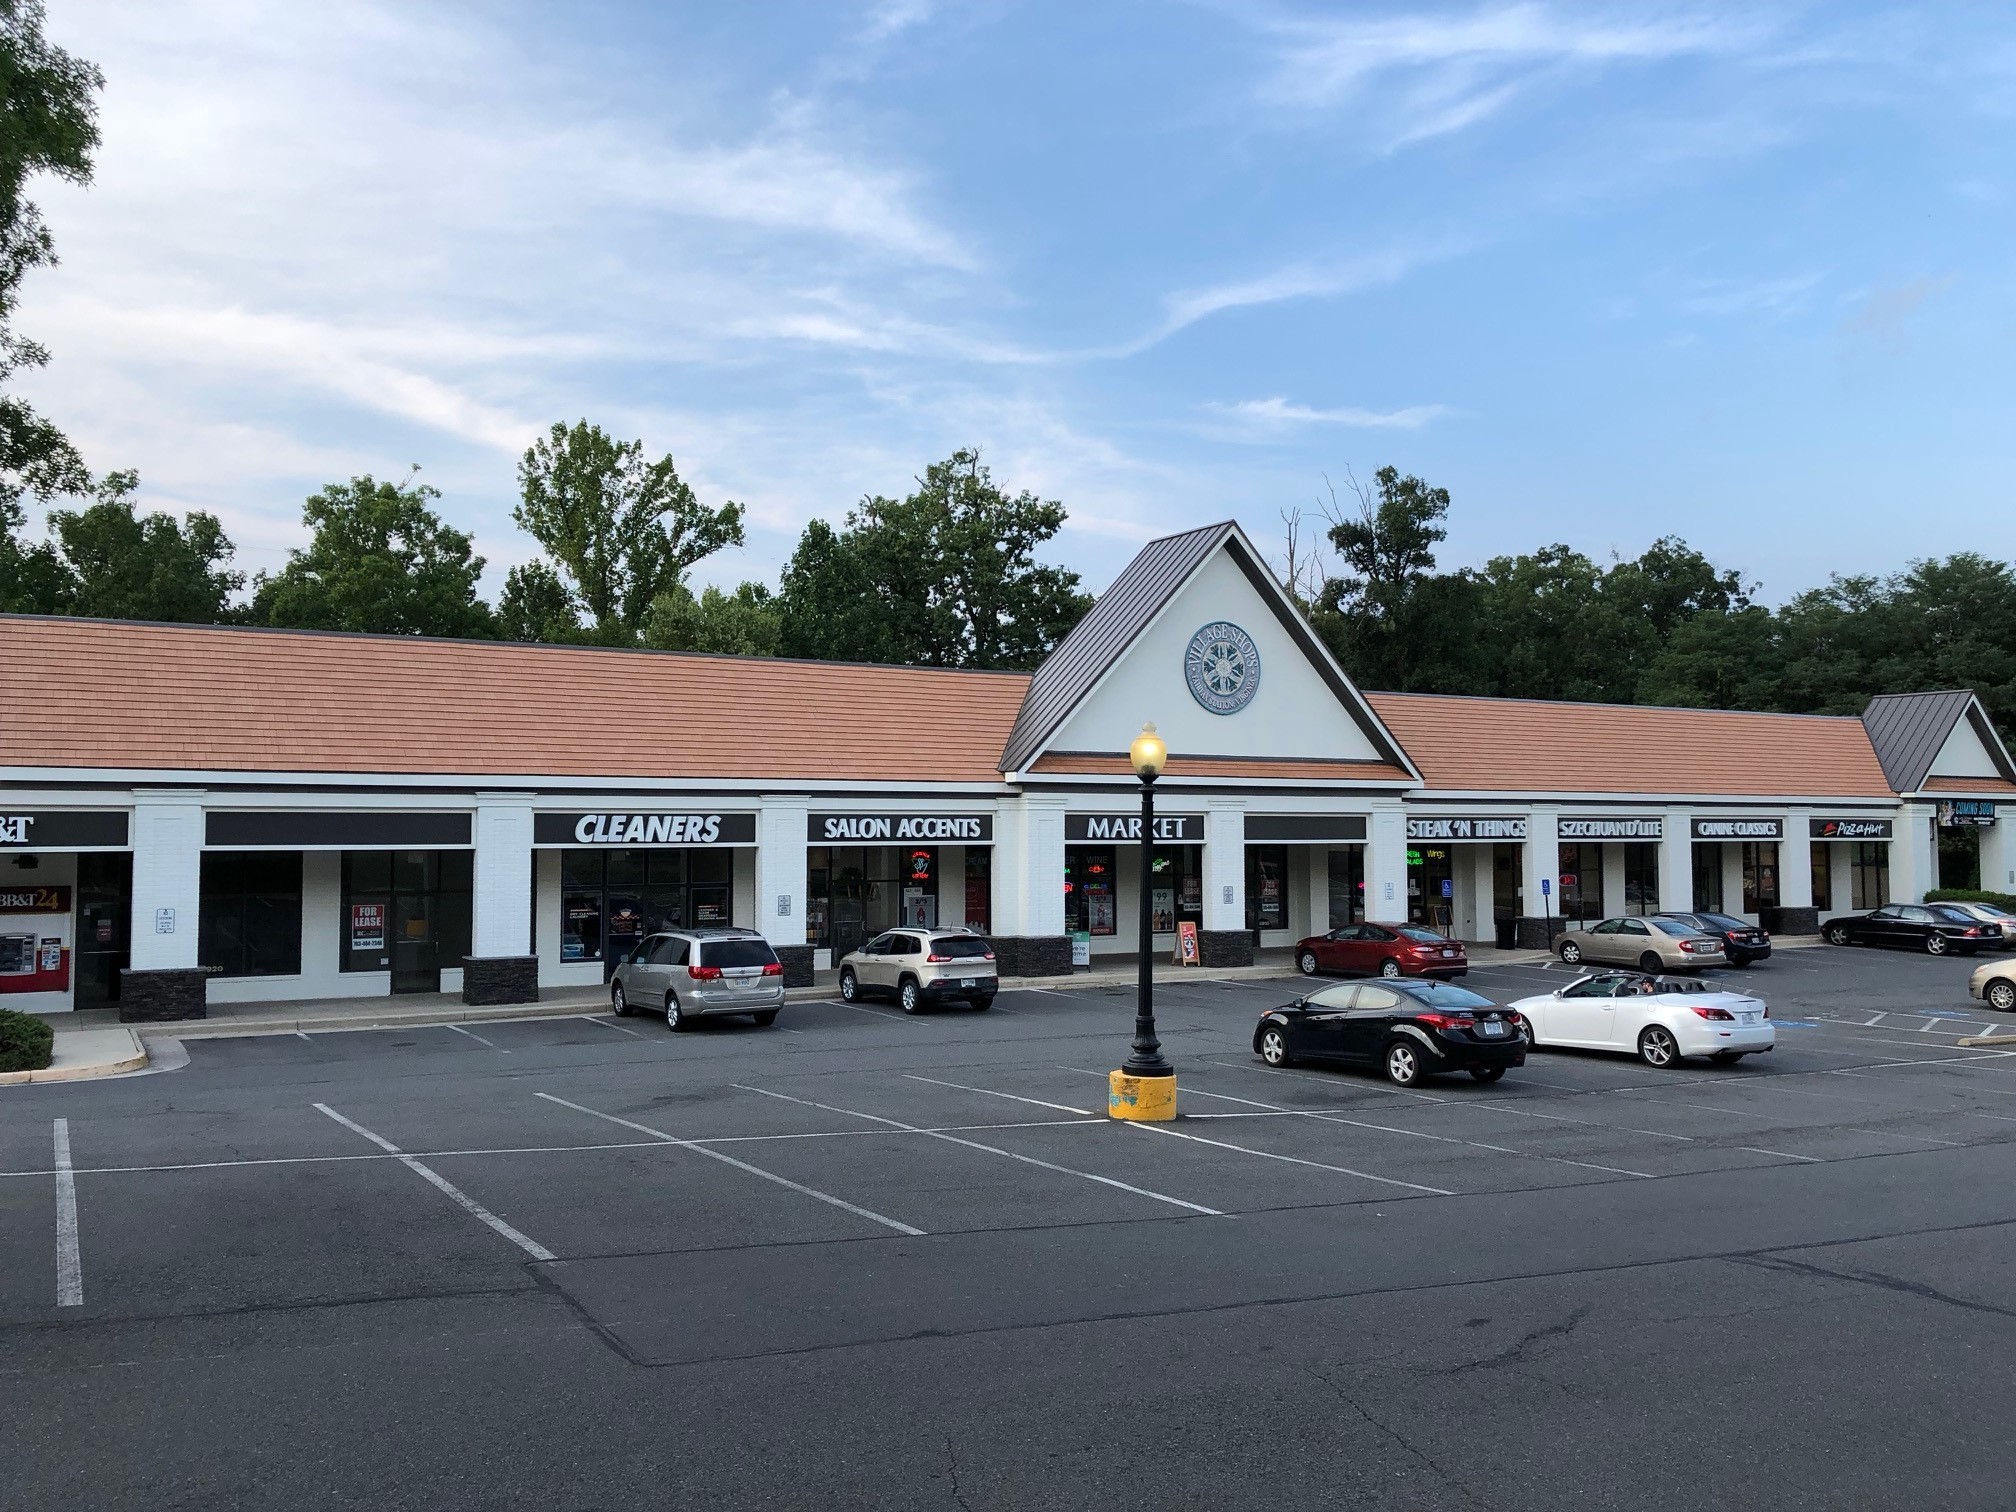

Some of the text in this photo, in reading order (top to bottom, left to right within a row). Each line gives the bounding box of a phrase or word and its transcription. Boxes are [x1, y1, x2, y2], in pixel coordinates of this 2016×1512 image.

[1188, 624, 1258, 667] VILLAGE SHOPS
[1192, 674, 1208, 701] FAIRFAX
[1236, 676, 1256, 704] VIRGINIA
[1955, 802, 1994, 815] COMING SOON
[575, 814, 722, 843] CLEANERS
[824, 818, 981, 838] SALON ACCENTS
[1407, 820, 1453, 837] STEAK
[1473, 820, 1527, 836] THINGS
[1559, 821, 1625, 835] SZECHUAN
[1698, 822, 1777, 835] CANINE CLASSICS
[1837, 822, 1884, 836] Pizza Hut
[1427, 850, 1445, 859] Wings
[37, 888, 58, 909] 24
[359, 907, 377, 916] FOR
[354, 917, 382, 927] LEASE
